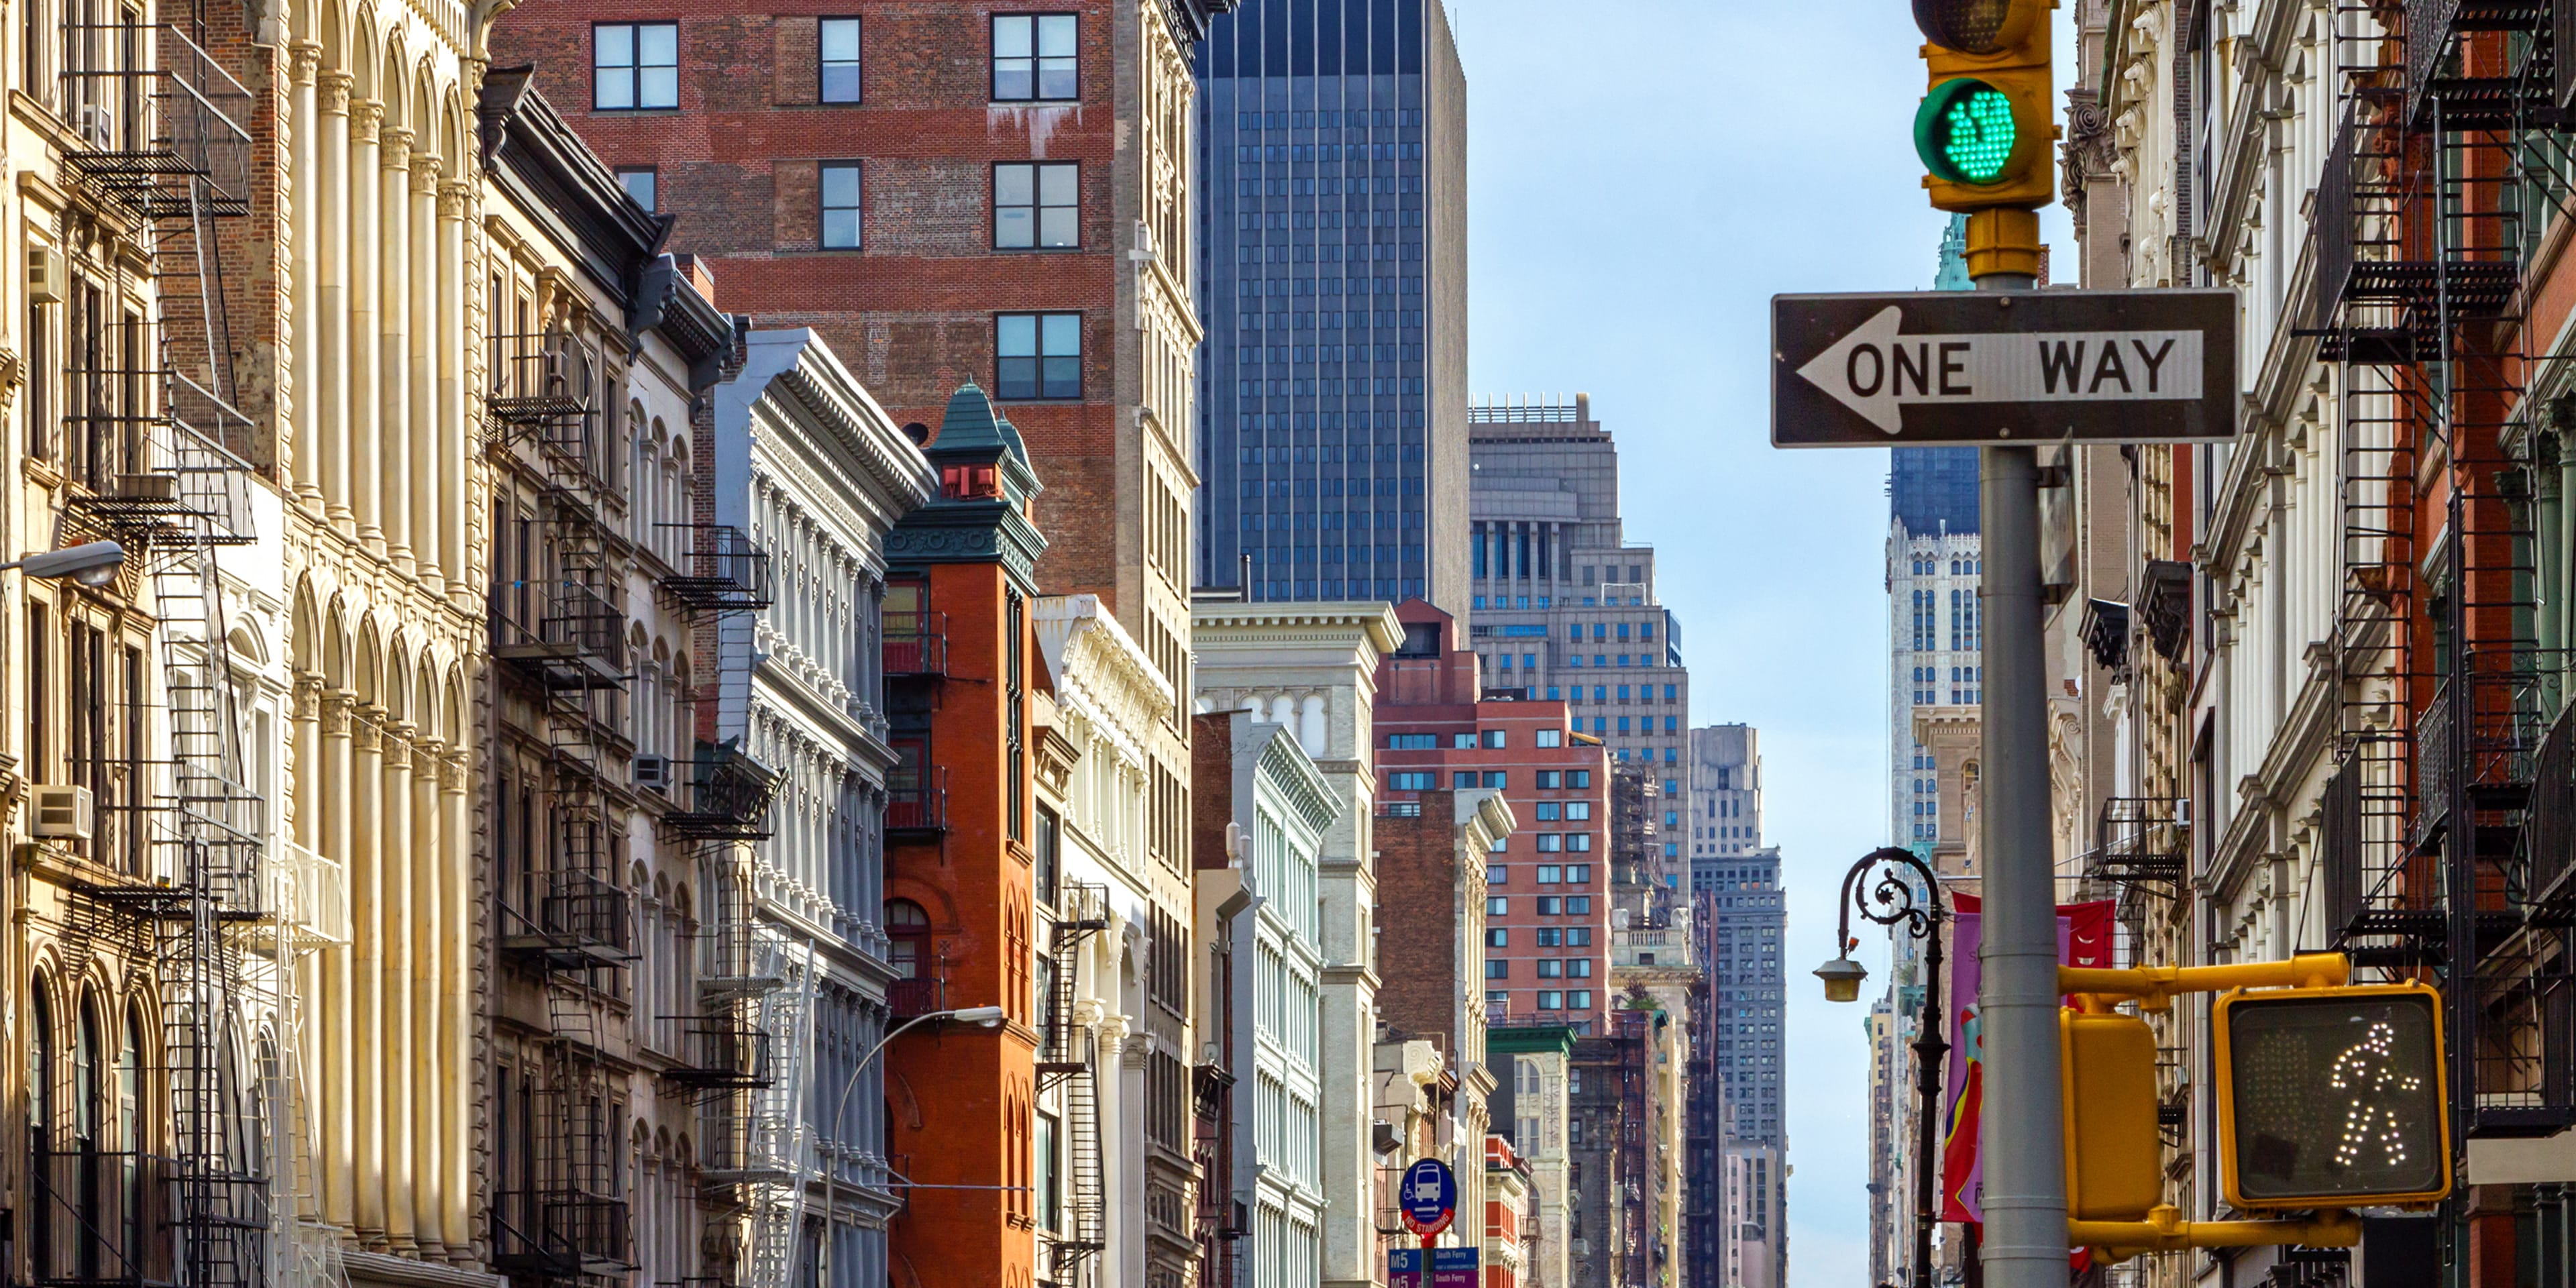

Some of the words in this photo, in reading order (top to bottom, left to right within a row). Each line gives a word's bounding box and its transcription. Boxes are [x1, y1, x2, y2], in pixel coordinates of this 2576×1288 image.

[1846, 341, 1972, 397] ONE
[2039, 339, 2176, 394] WAY
[1405, 1215, 1415, 1228] NO
[1417, 1213, 1449, 1234] STANDING
[1391, 1252, 1408, 1269] M5
[1452, 1250, 1466, 1260] Ferry
[1391, 1275, 1409, 1288] M5
[1451, 1274, 1466, 1283] Ferry
